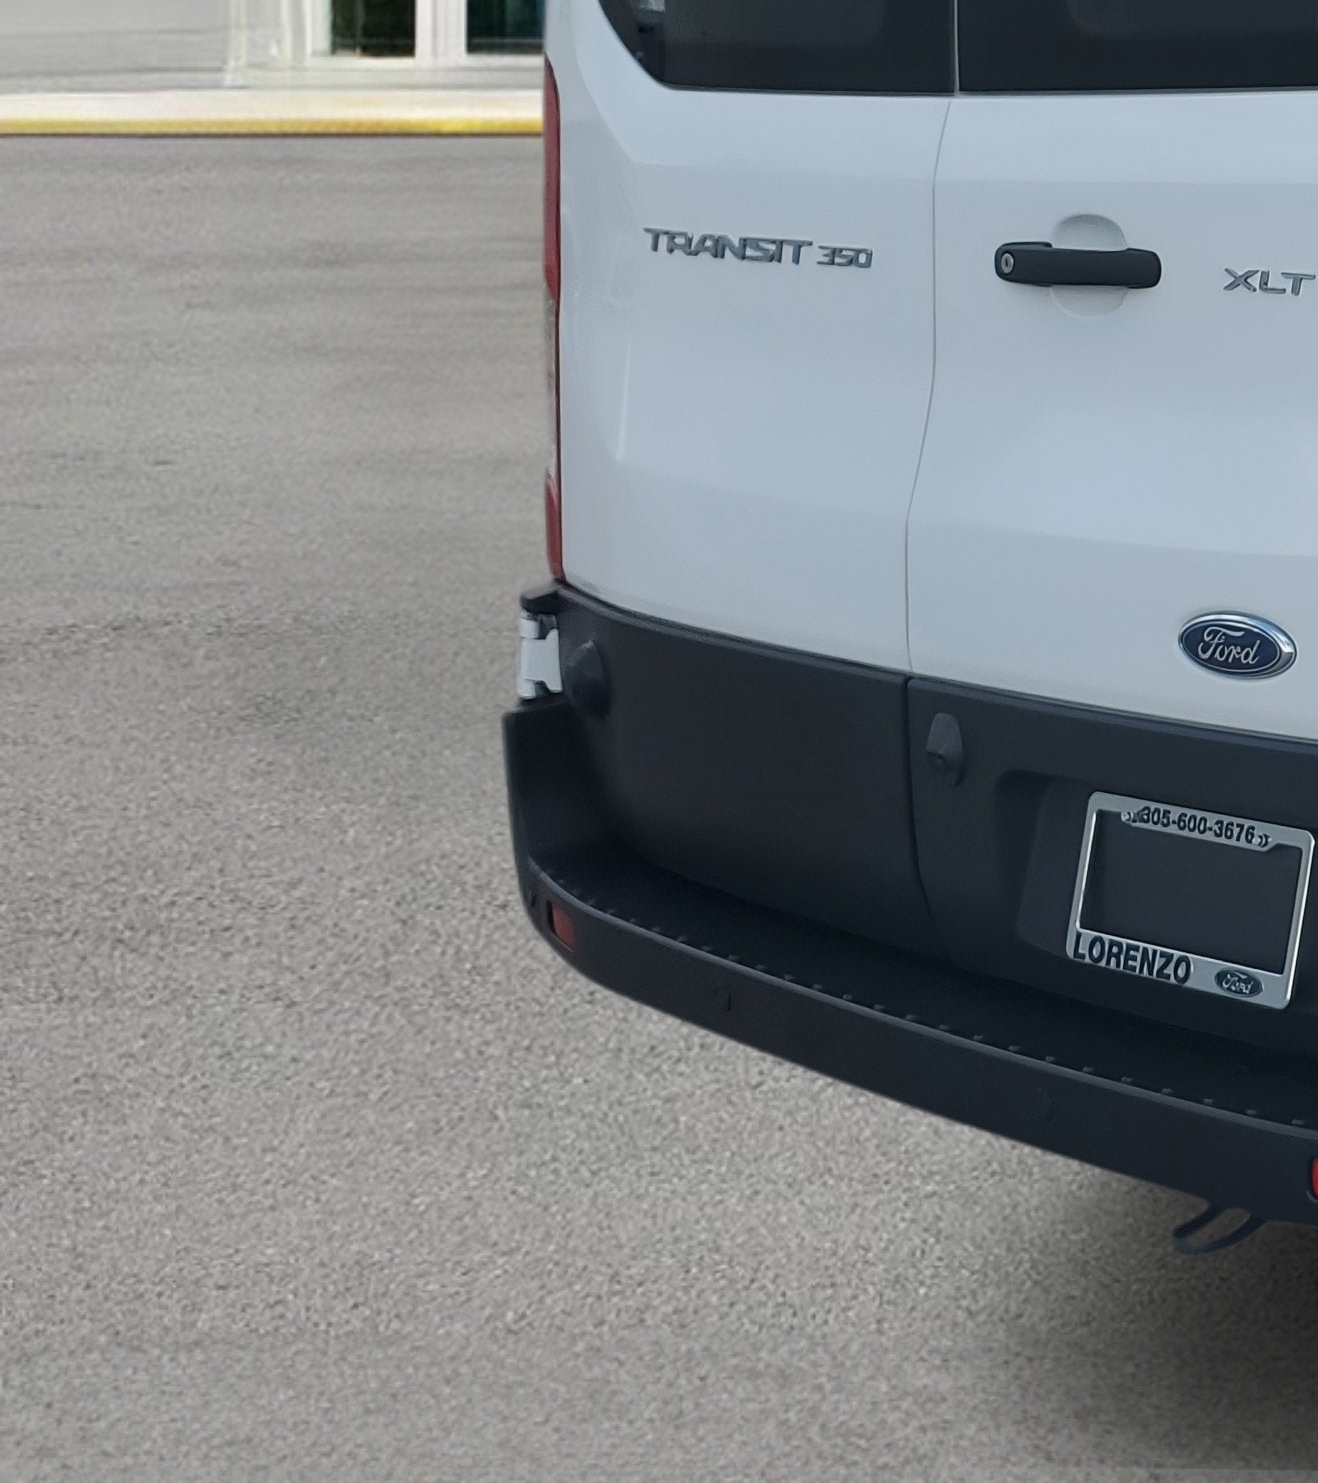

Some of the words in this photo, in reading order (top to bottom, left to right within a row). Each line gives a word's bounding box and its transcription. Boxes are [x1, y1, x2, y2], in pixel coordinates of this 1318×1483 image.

[643, 227, 813, 265] TRANSIT
[816, 245, 873, 268] 350
[1223, 268, 1316, 296] XLT
[1197, 626, 1261, 665] Ford
[1139, 805, 1257, 844] 305-600-3676
[1073, 932, 1192, 985] LORENZO
[1221, 971, 1255, 995] Ford
